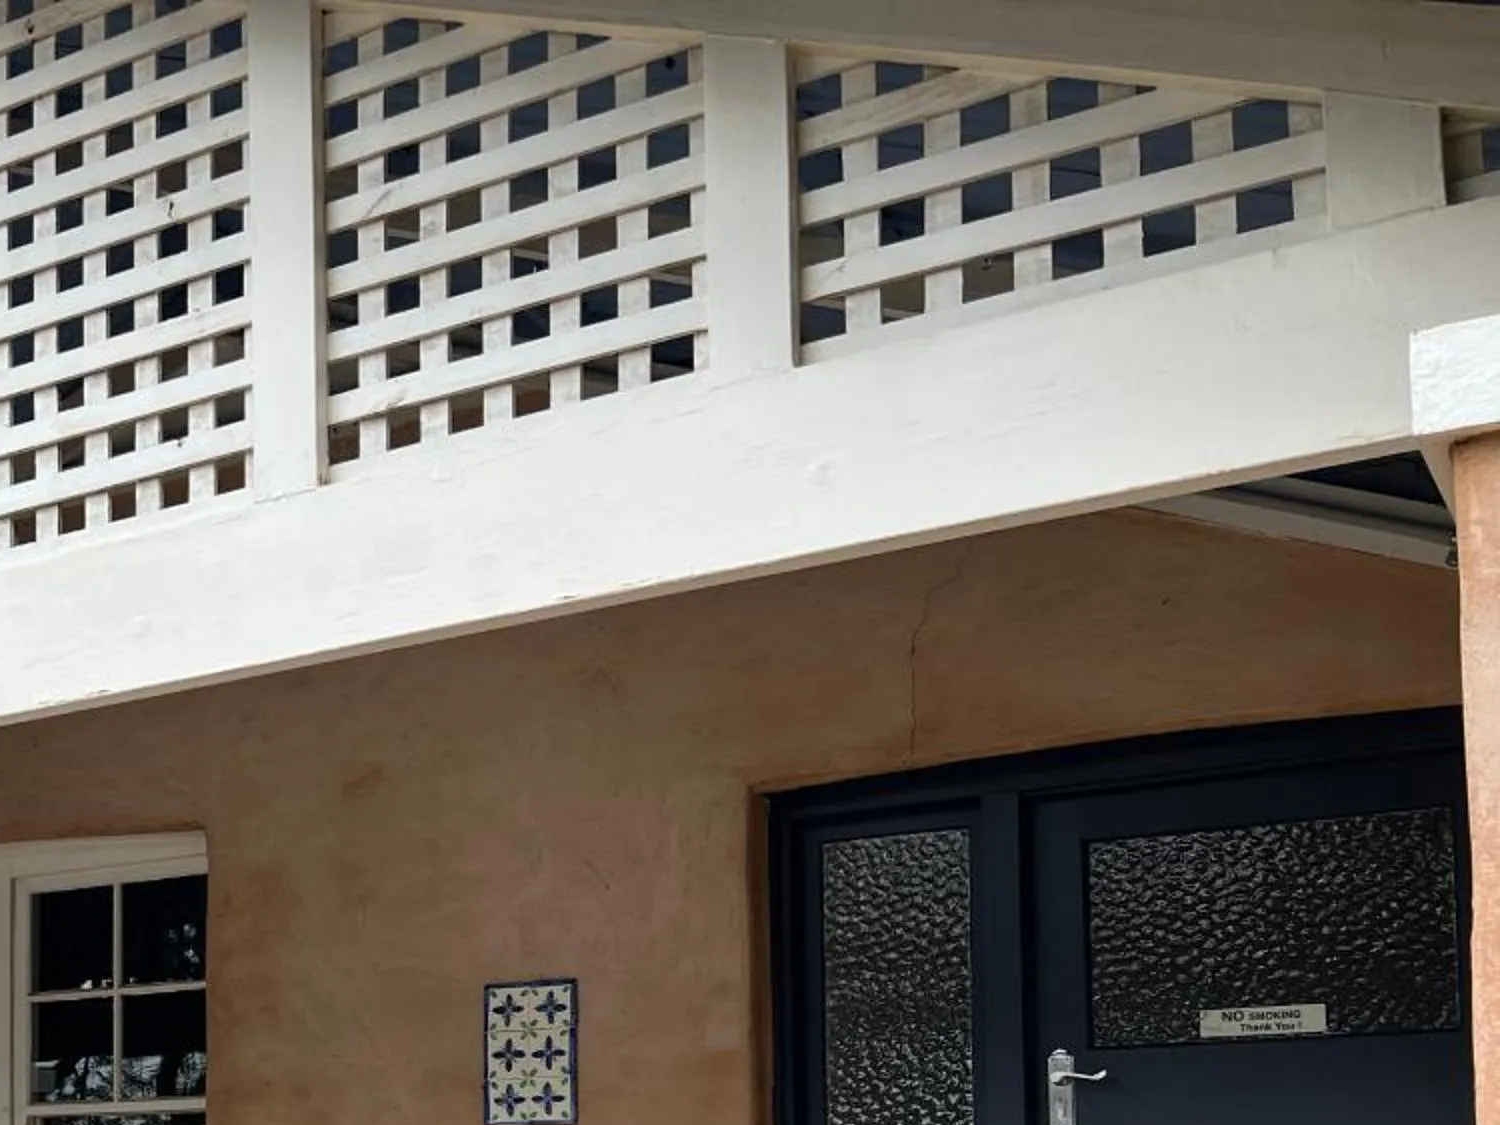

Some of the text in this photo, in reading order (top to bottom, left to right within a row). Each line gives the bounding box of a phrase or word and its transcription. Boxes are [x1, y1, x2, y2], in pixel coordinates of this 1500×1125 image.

[1221, 1009, 1301, 1022] NO SMOKING
[1240, 1022, 1272, 1032] Thank
